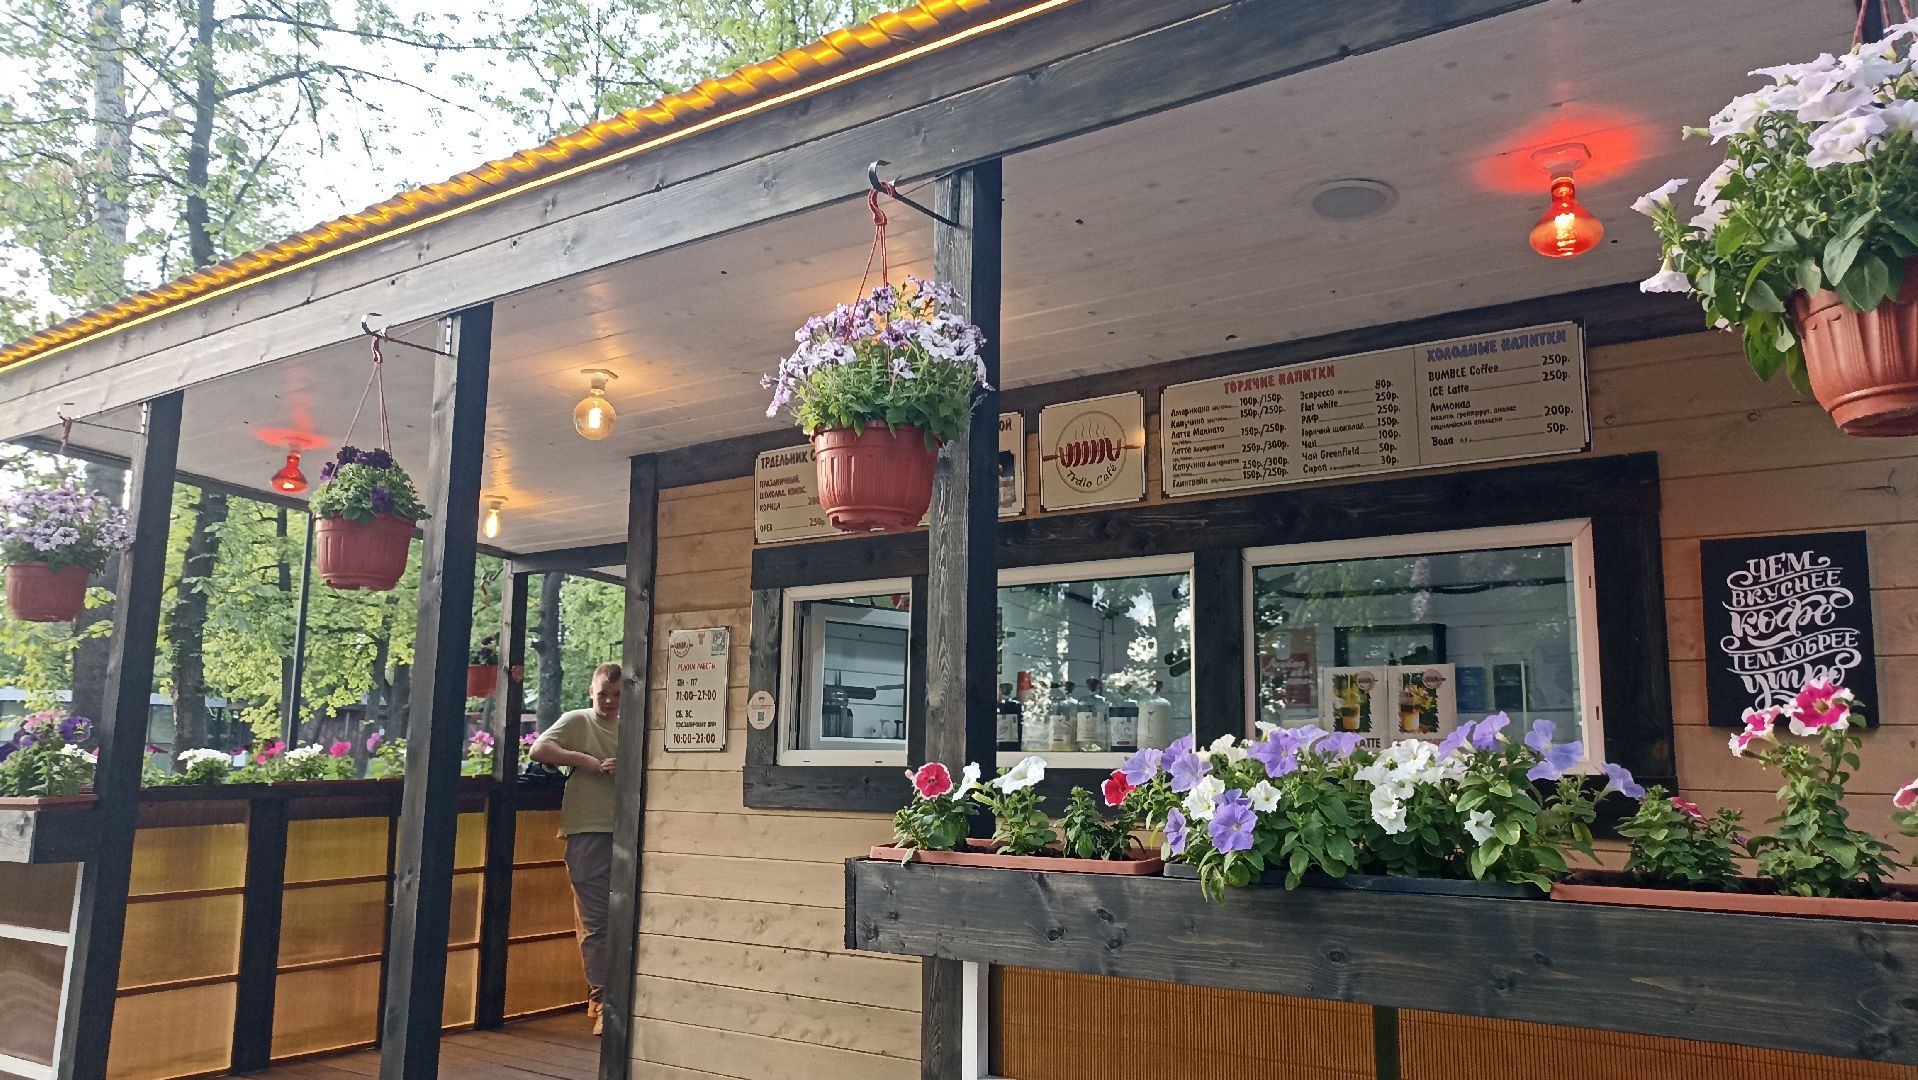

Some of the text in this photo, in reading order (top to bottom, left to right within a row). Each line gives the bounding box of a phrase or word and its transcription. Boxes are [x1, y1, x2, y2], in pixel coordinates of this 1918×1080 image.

[1427, 330, 1566, 362] ХОЛОДНЫЕ НАПИТКИ
[1428, 354, 1570, 381] BUMBLE Coffee 250р.
[1224, 365, 1335, 394] ГОРЯЧИЕ НАПИТКИ
[1429, 370, 1570, 397] ICE Latte 250р.
[1300, 389, 1334, 400] Эспрессо
[1375, 379, 1393, 390] 80р.
[1171, 406, 1209, 417] Американо
[1240, 393, 1284, 406] 100р./150р.
[1301, 391, 1399, 412] Flat white 250р.
[1430, 400, 1471, 412] Лимонад
[1240, 405, 1285, 418] 150р./250р.
[1301, 404, 1400, 424] РАФ 250р.
[1474, 416, 1502, 426] апельсин
[1544, 404, 1573, 417] 200р.
[1171, 430, 1190, 439] Латте
[1241, 423, 1287, 437] 150р./250р.
[1301, 417, 1400, 437] Горячий шоколад 150р.
[1431, 437, 1454, 446] Вода
[1546, 422, 1569, 434] 50р.
[1242, 440, 1290, 453] 250р./300р.
[1301, 429, 1401, 449] Чай 100р.
[1171, 444, 1191, 454] Латте
[1302, 442, 1397, 460] Чай Greenfield 50р.
[761, 451, 808, 469] ТРДЕЛЬНИК
[1242, 456, 1290, 470] 250р./300р.
[1303, 464, 1327, 474] Сироп
[1380, 455, 1399, 465] 30р.
[1067, 470, 1093, 488] Trdlo
[1243, 468, 1289, 480] 150р./250р.
[760, 503, 780, 512] КОРИЦА
[760, 524, 773, 532] ОРЕХ
[1745, 551, 1831, 582] ЧЕМ
[1731, 570, 1841, 607] ВКУСНЕЕ
[1729, 632, 1859, 671] ТЕМ ДОБРЕЕ
[677, 662, 716, 673] РЕЖИМ РАБОТЫ
[690, 678, 698, 686] ПТ
[676, 689, 717, 701] 11:00-21:00
[673, 732, 716, 744] 10:00-21:00
